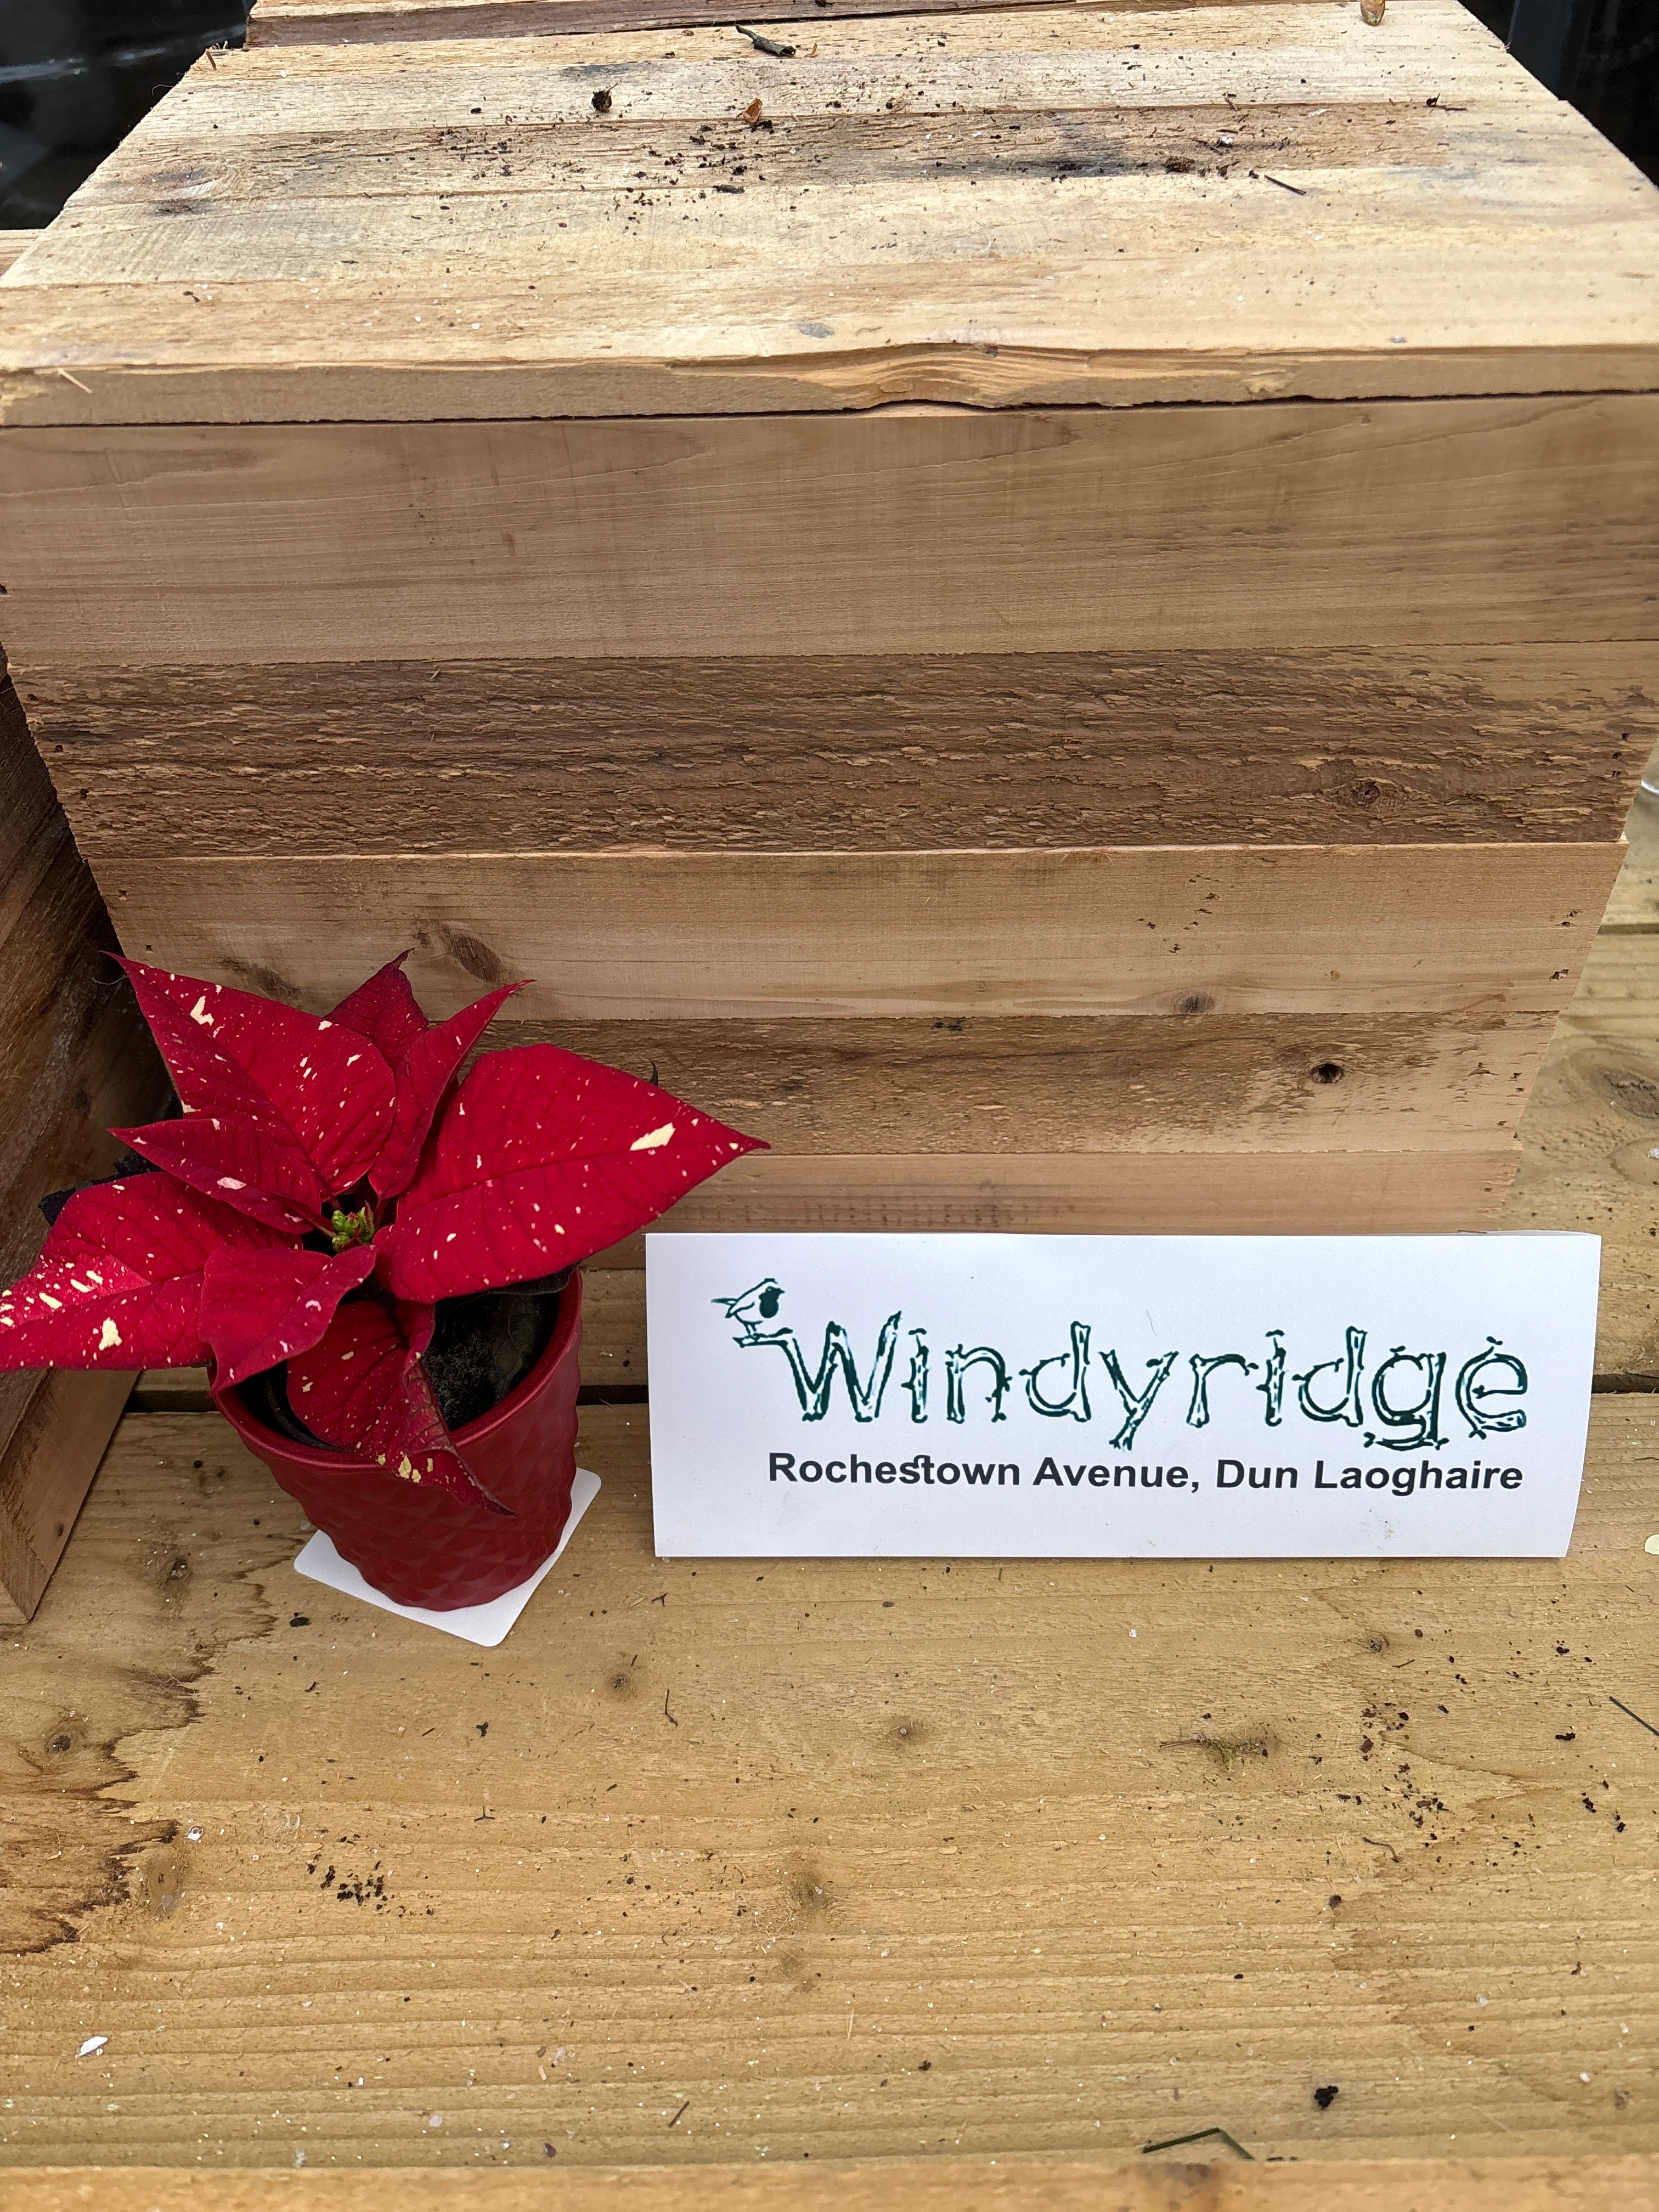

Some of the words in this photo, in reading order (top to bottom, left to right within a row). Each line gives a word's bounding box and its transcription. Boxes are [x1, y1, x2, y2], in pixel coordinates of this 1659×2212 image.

[733, 1311, 1528, 1451] Windyridge
[769, 1452, 1020, 1486] Rochestown
[1032, 1457, 1200, 1494] Avenue,
[1216, 1459, 1298, 1489] Dun
[1314, 1460, 1523, 1497] Laoghaire
